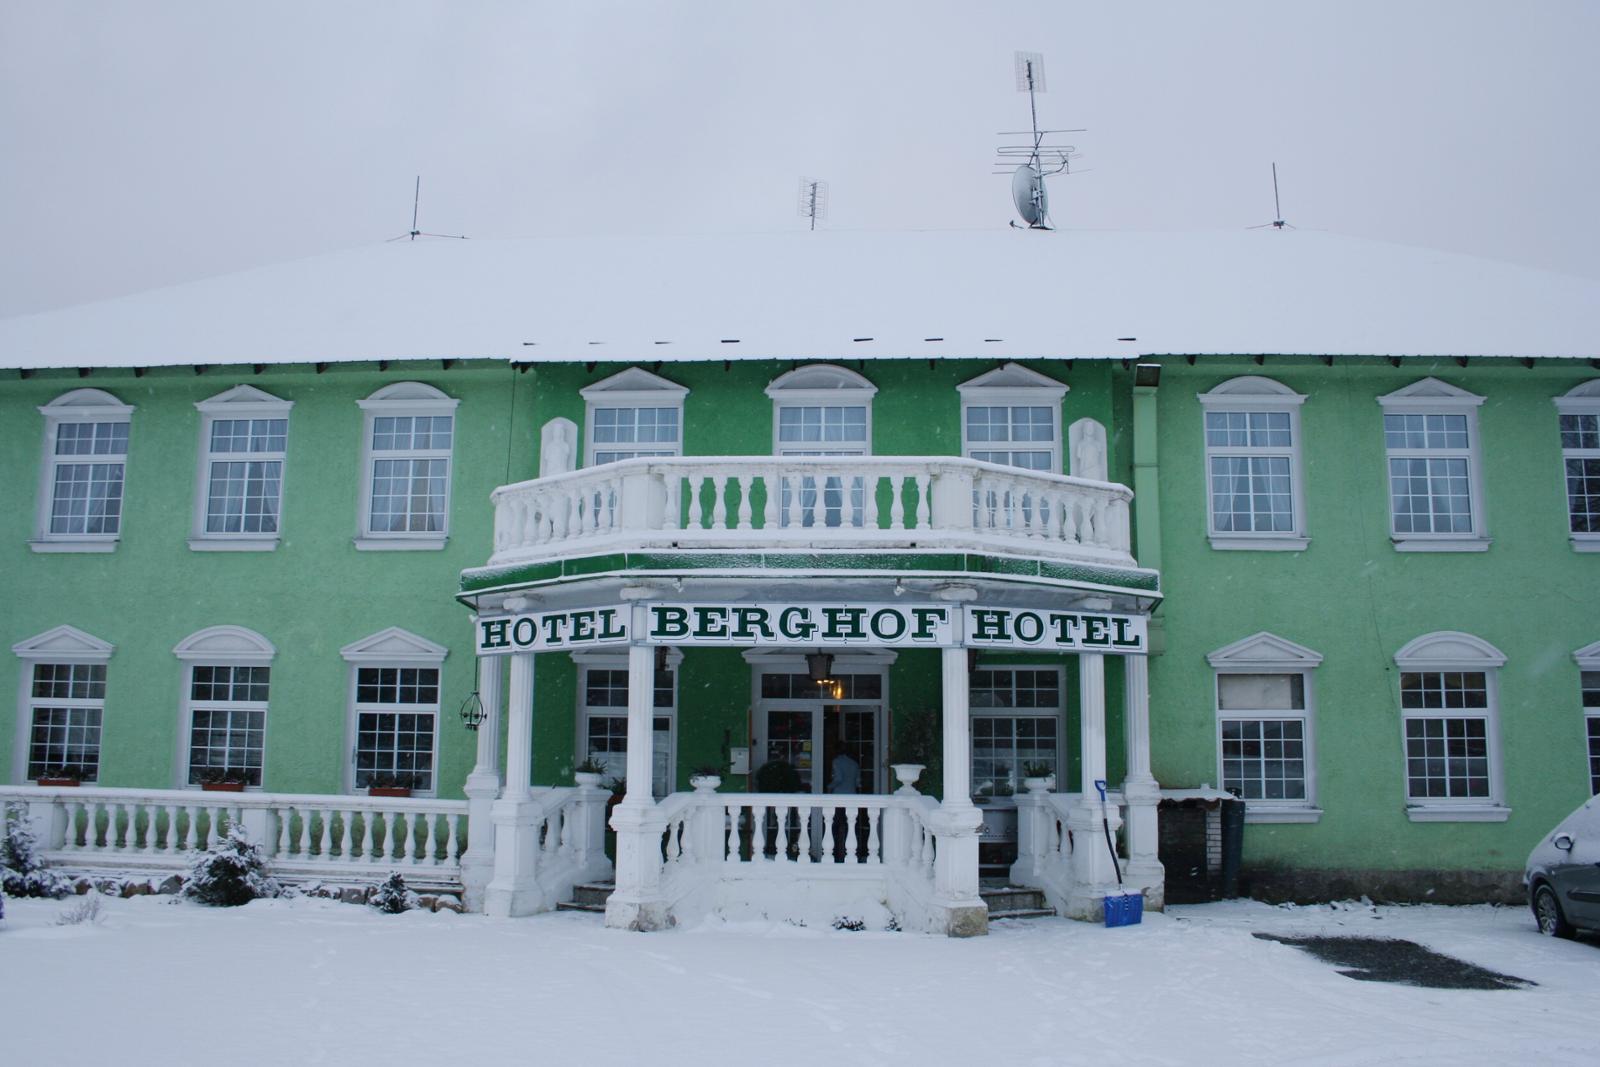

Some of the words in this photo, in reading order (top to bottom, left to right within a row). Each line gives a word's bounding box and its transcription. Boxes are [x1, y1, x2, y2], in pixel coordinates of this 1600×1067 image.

[480, 609, 627, 648] HOTEL
[650, 606, 948, 641] BERGHOF
[971, 609, 1141, 647] HOTEL
